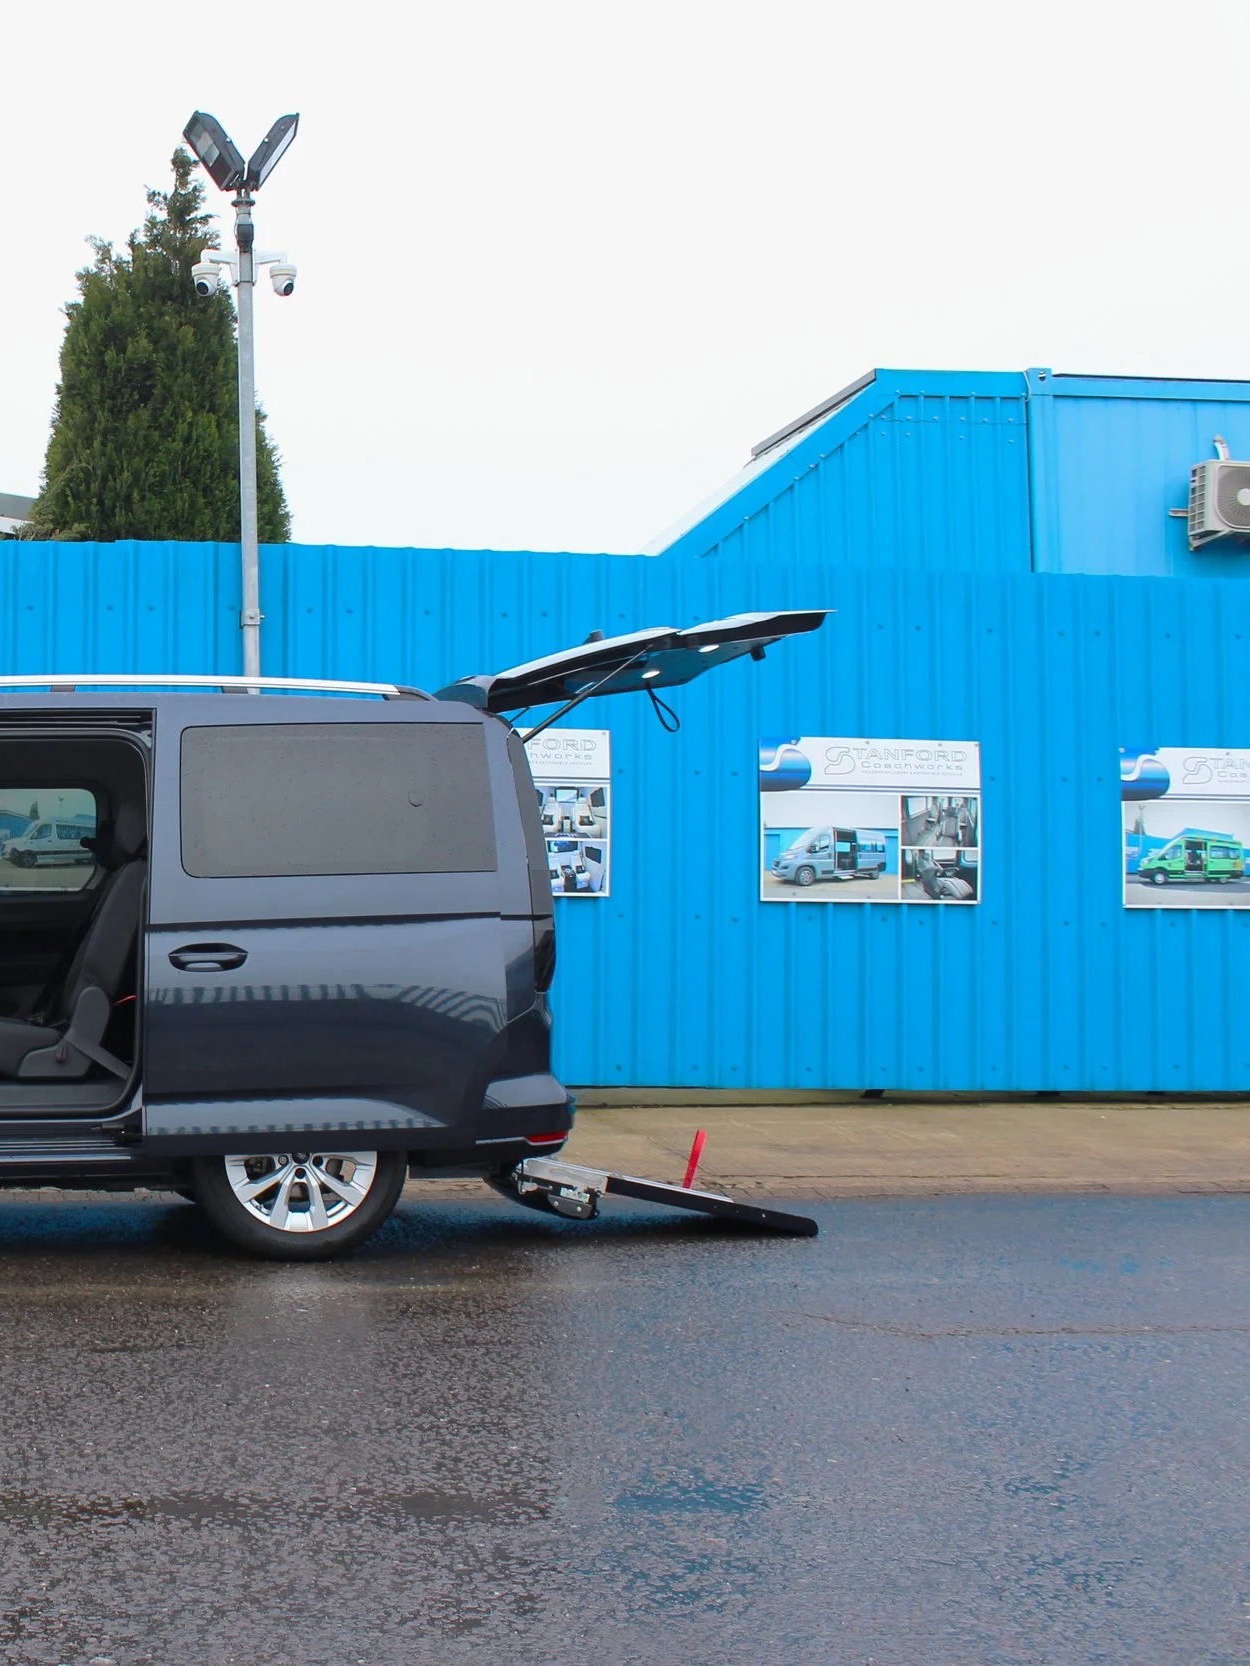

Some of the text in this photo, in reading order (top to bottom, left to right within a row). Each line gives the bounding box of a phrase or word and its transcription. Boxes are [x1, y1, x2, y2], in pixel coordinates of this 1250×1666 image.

[527, 738, 597, 751] FORD
[824, 746, 967, 775] STANFORD
[861, 760, 963, 770] Coachworks
[1182, 756, 1250, 785] STAN
